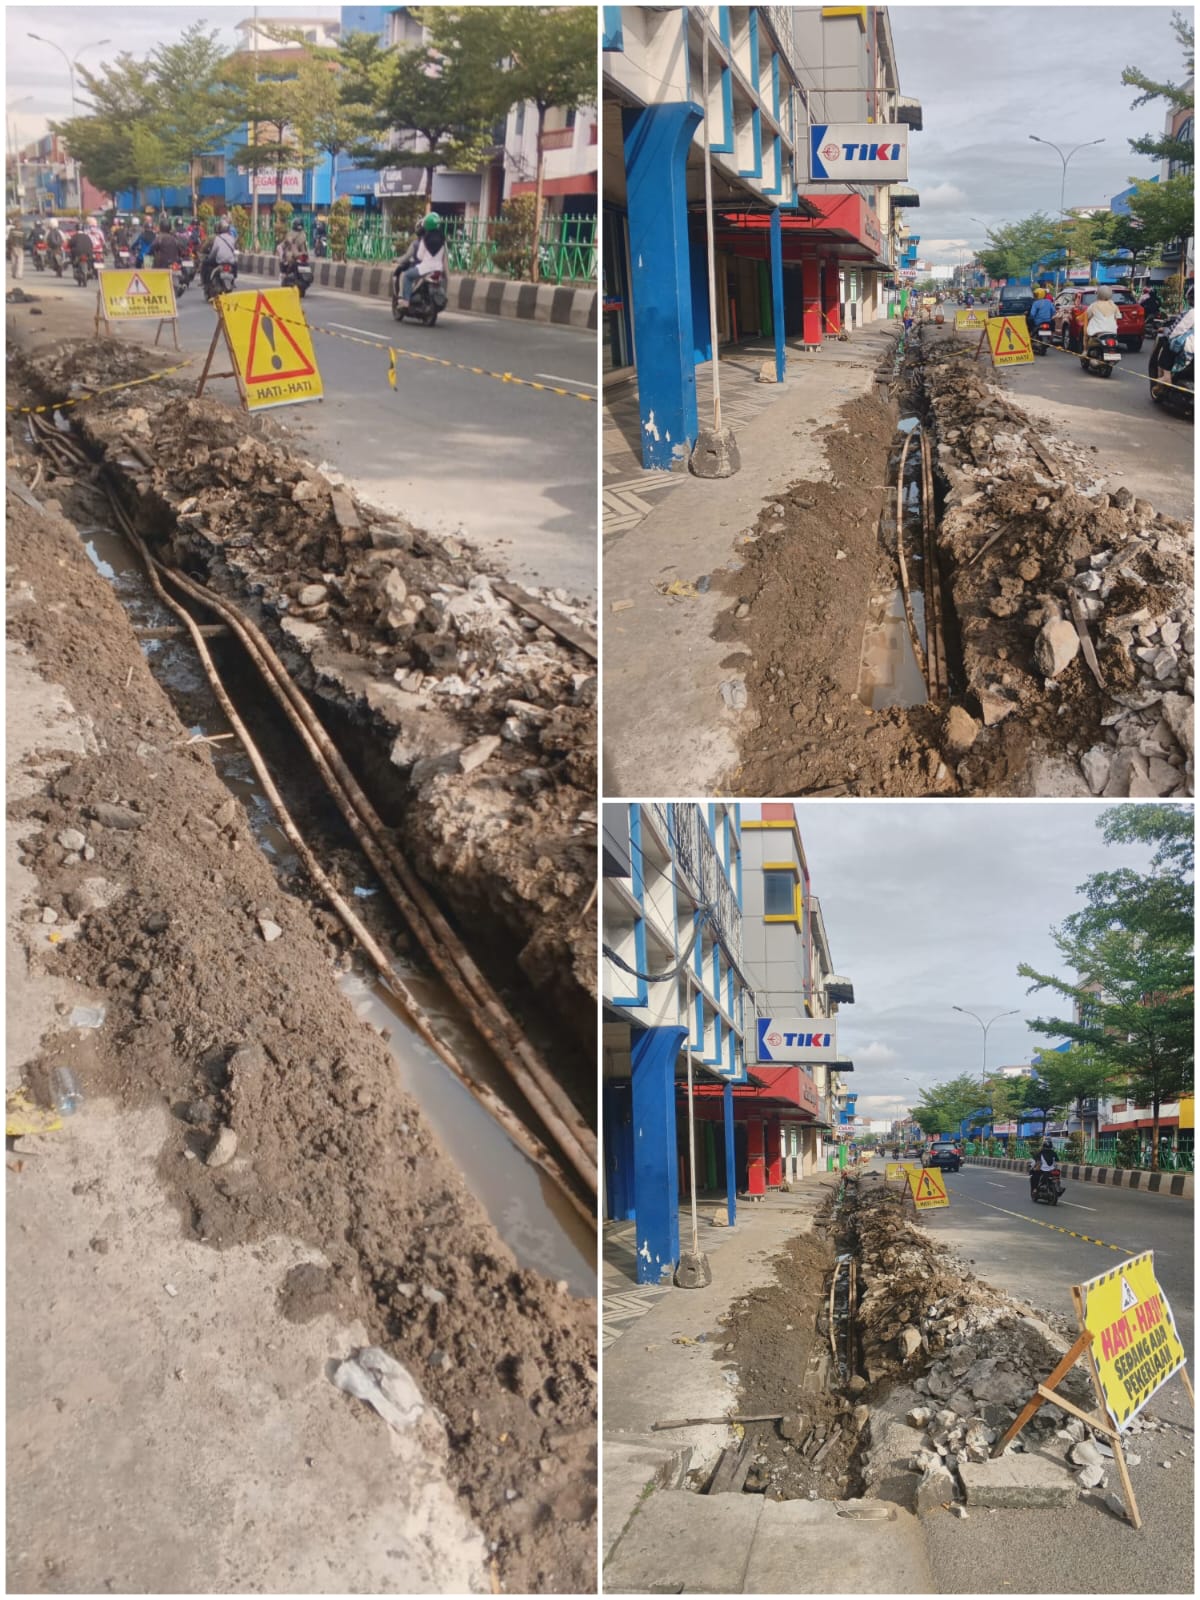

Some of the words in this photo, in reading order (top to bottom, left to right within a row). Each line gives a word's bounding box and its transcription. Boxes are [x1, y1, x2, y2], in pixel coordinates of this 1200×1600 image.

[842, 143, 901, 161] TIKI
[143, 295, 168, 305] HATI
[256, 385, 282, 399] HATI
[288, 381, 312, 394] HATI
[783, 1032, 831, 1047] TIKI
[1100, 1314, 1133, 1362] HATI
[1114, 1336, 1151, 1381] SEDANG
[1149, 1324, 1168, 1352] ADA
[1123, 1343, 1173, 1401] PEKERJAAN
